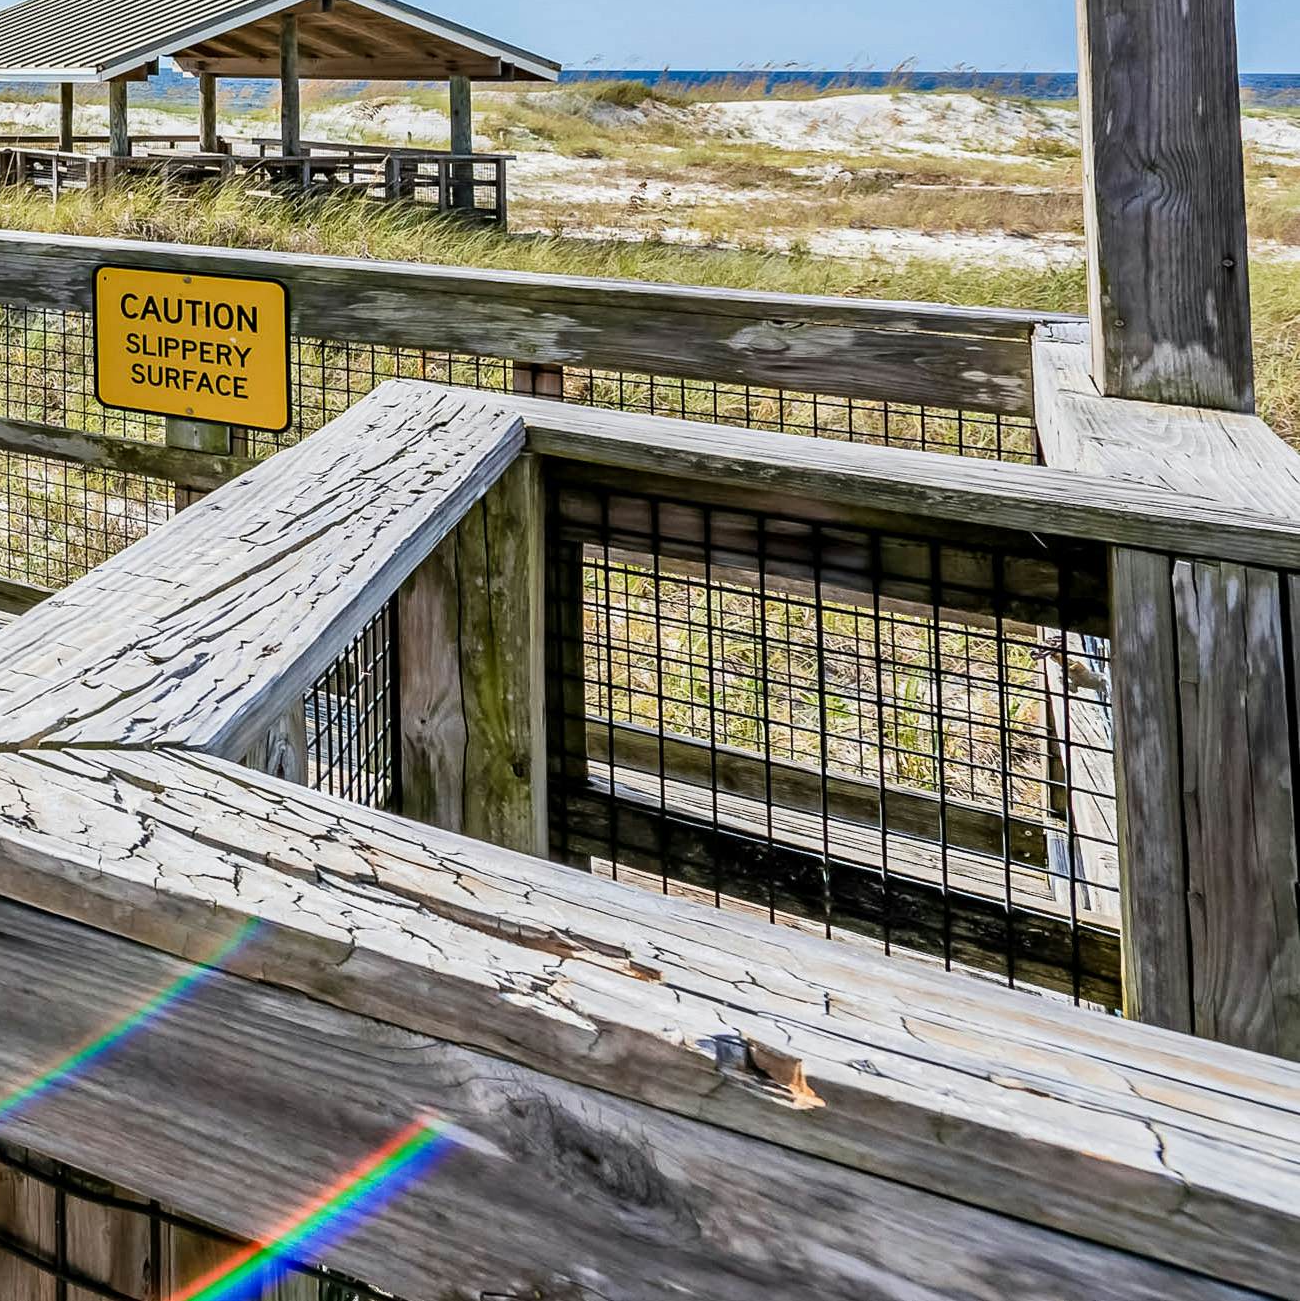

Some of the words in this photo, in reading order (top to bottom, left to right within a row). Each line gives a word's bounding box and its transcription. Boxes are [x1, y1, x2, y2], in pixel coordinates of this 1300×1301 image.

[120, 293, 258, 333] CAUTION
[126, 333, 252, 368] SLIPPERY
[131, 364, 249, 399] SURFACE
